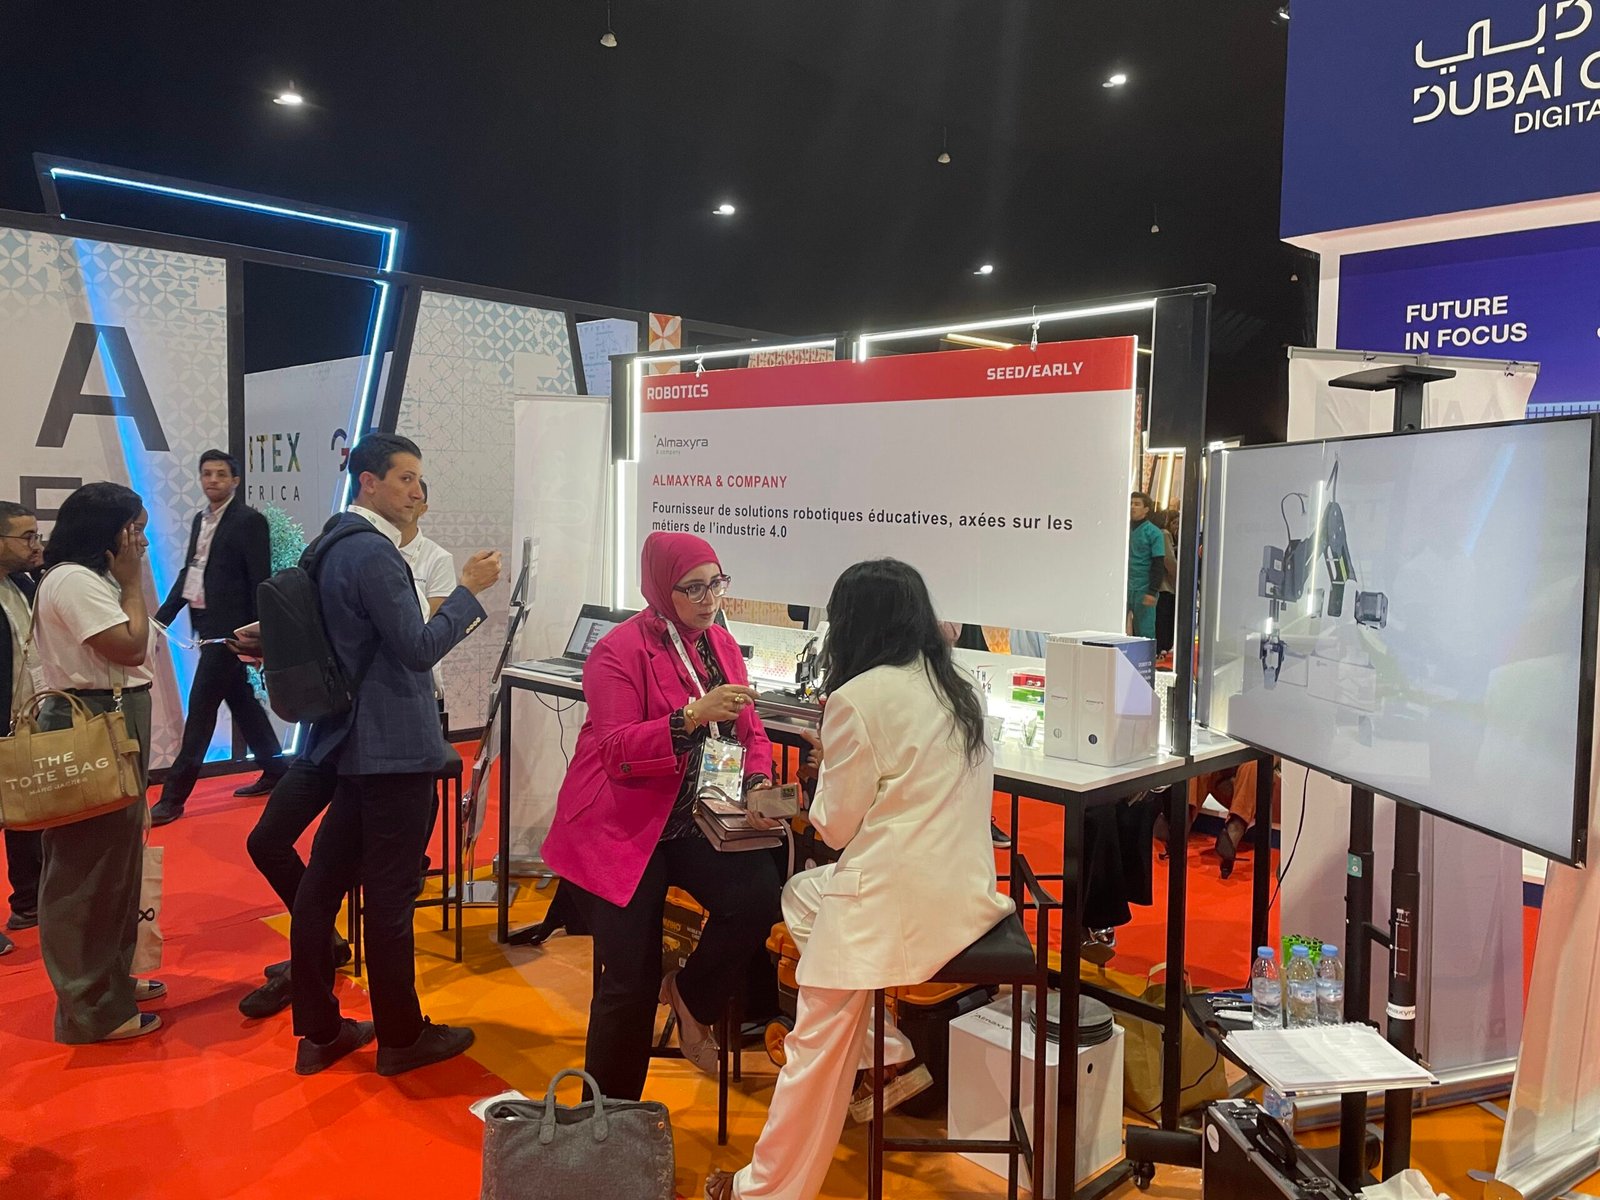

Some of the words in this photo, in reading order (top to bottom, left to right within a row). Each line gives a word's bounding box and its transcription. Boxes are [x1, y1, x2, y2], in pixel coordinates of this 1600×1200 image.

[1413, 56, 1563, 124] DUBAI
[1514, 100, 1600, 134] DIGITA
[1406, 295, 1509, 323] FUTURE
[1405, 331, 1429, 350] IN
[1437, 322, 1528, 348] FOCUS
[647, 384, 709, 400] ROBOTICS
[987, 362, 1083, 380] SEED/EARLY
[249, 432, 301, 472] ITEX
[248, 485, 301, 501] FRICA
[652, 474, 712, 487] ALMAXYRA
[716, 475, 723, 487] &
[727, 475, 787, 488] COMPANY
[652, 501, 714, 516] Fournisseur
[718, 503, 731, 516] de
[735, 505, 789, 519] solutions
[793, 507, 863, 524] robotiques
[868, 509, 953, 528] éducatives,
[959, 512, 1006, 528] axées
[1013, 515, 1041, 529] sur
[1047, 515, 1073, 530] les
[652, 520, 689, 532] métiers
[693, 521, 706, 533] de
[709, 522, 766, 537] l'industrie
[769, 525, 787, 538] 4.0
[6, 770, 58, 790] TOTE
[65, 757, 110, 777] BAG
[34, 751, 74, 769] THE
